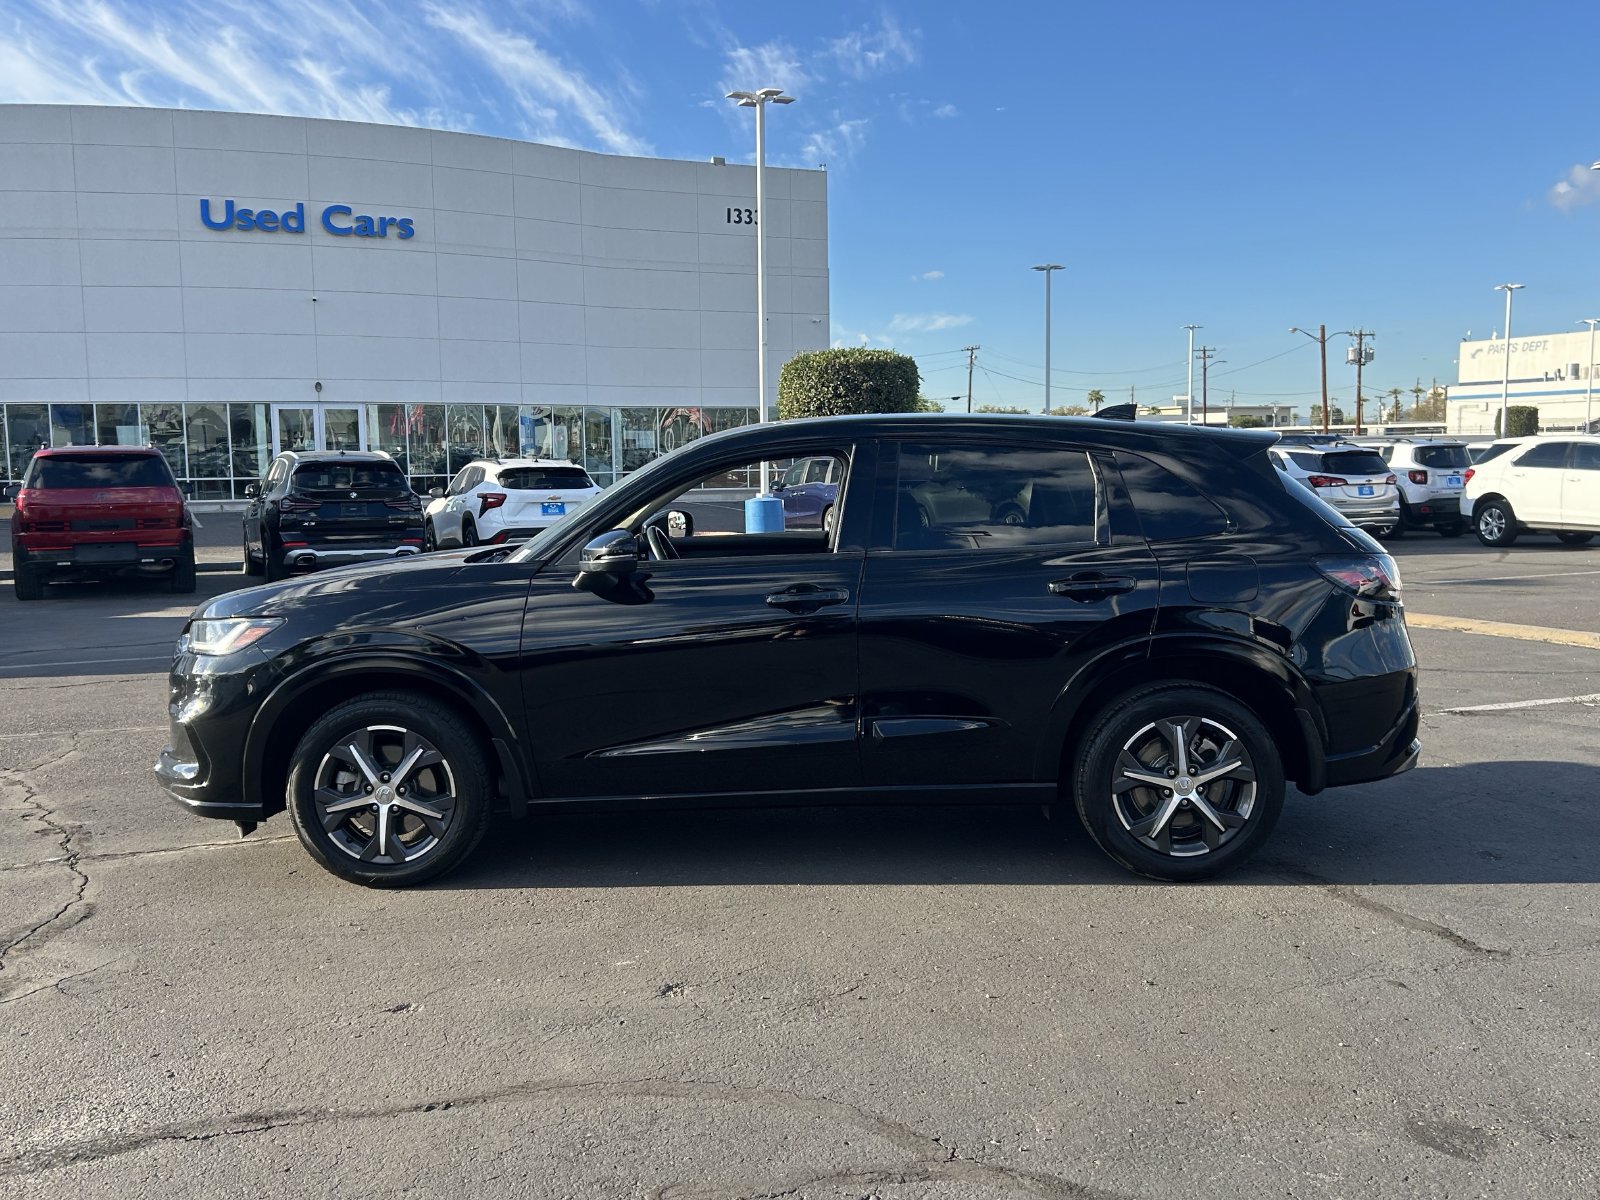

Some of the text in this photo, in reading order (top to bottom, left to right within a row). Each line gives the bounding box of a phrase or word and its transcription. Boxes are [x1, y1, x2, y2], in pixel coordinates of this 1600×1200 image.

[200, 199, 415, 239] Used Cars
[727, 207, 758, 225] 133
[1488, 339, 1549, 355] PARS DEPT.
